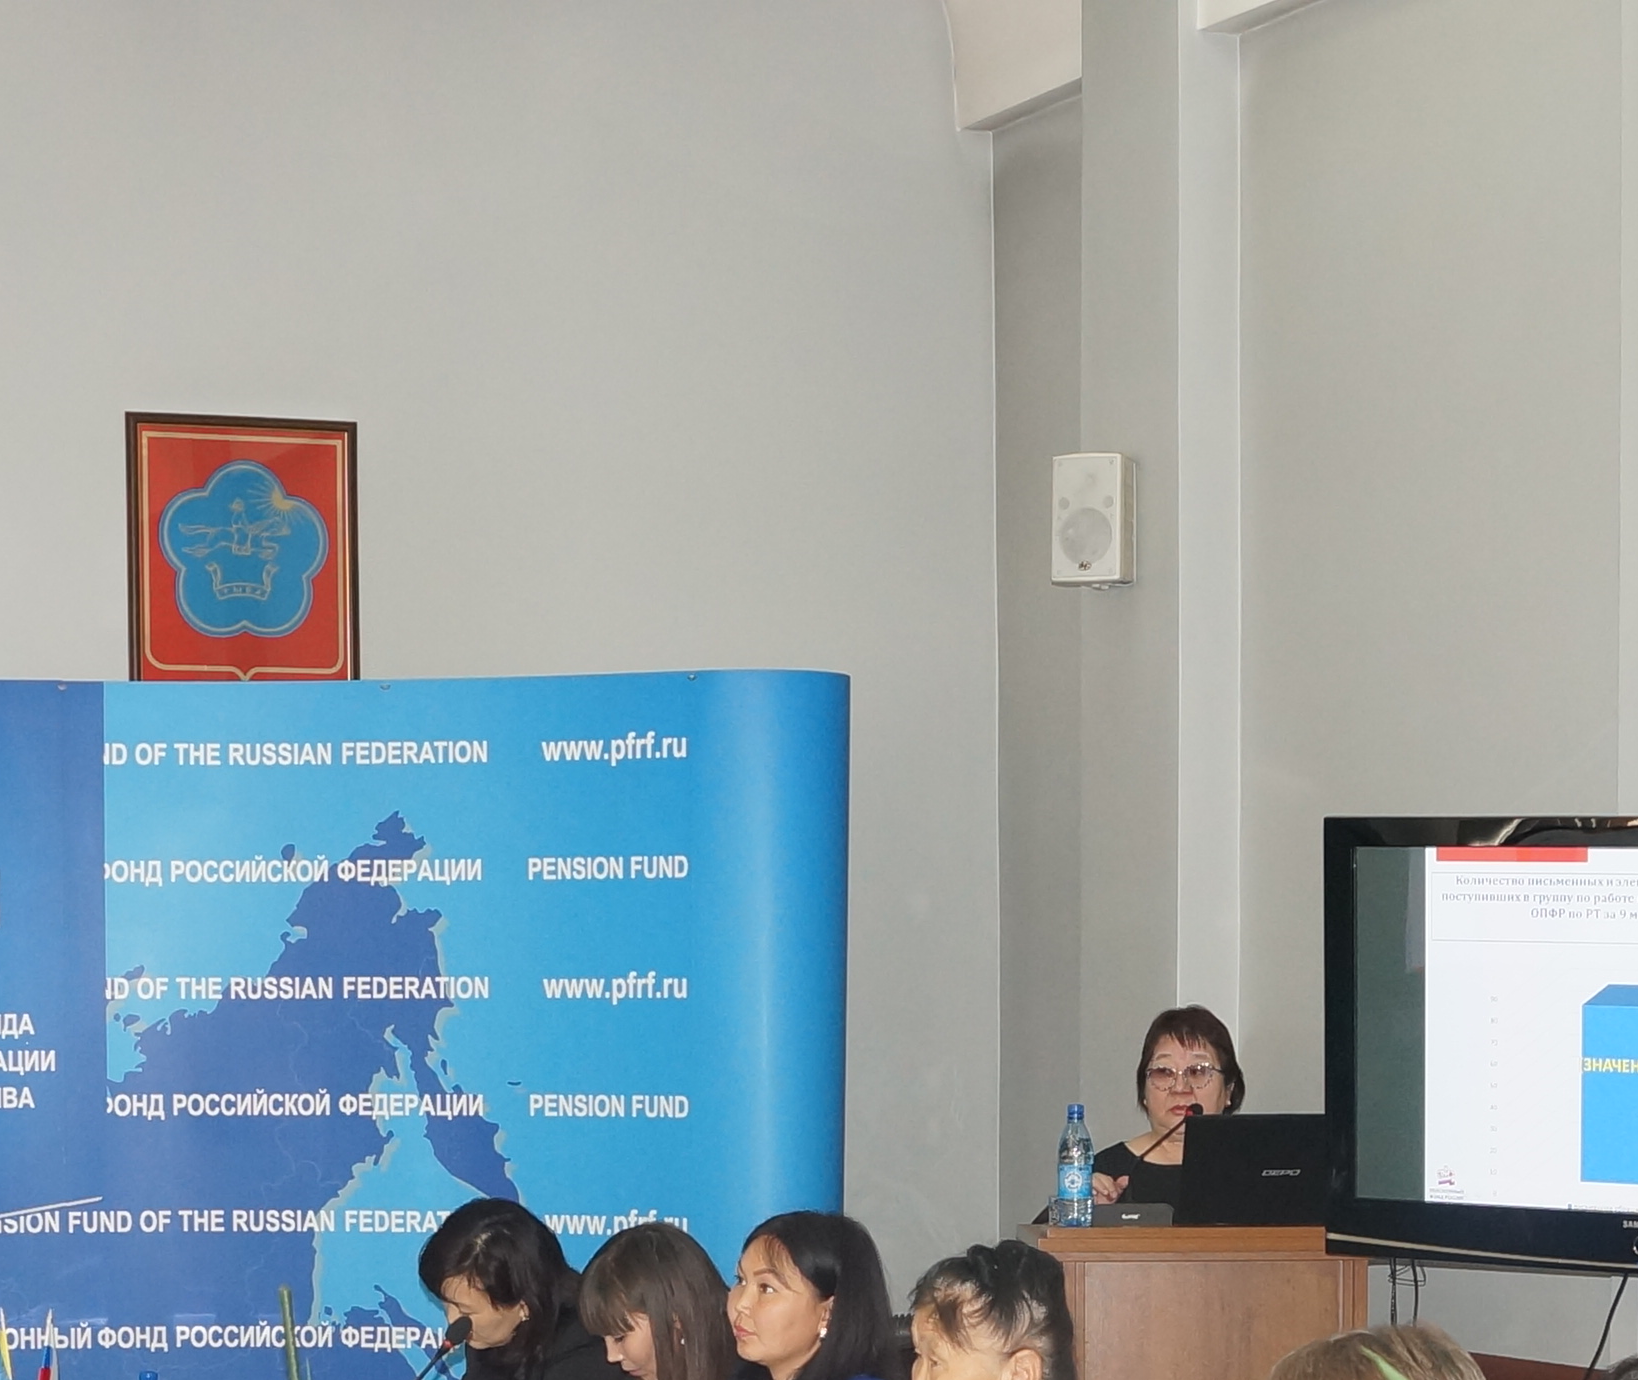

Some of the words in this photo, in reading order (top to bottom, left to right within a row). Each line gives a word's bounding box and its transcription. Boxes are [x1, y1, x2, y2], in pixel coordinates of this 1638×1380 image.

[134, 742, 168, 766] OF
[173, 743, 222, 766] THE
[228, 742, 332, 766] RUSSIAN
[341, 740, 488, 765] FEDERATION
[541, 730, 687, 767] www.pfrf.ru
[170, 854, 329, 883] РОССИЙСКОЙ
[336, 858, 482, 887] ФЕДЕРАЦИИ
[528, 856, 624, 881] PENSION
[630, 855, 689, 879] FUND
[1455, 874, 1523, 887] Количество
[1593, 892, 1635, 906] работе
[1530, 908, 1566, 920] ОПФР
[1585, 909, 1601, 919] РТ
[1619, 909, 1627, 919] 9
[136, 976, 169, 1000] OF
[175, 977, 223, 1000] THE
[229, 976, 333, 1000] RUSSIAN
[343, 975, 489, 1000] FEDERATION
[542, 970, 688, 1006] www.pfrf.ru
[172, 1088, 331, 1116] РОССИЙСКОЙ
[338, 1092, 484, 1121] ФЕДЕРАЦИИ
[529, 1093, 625, 1118] PENSION
[631, 1094, 689, 1119] FUND
[1261, 1169, 1301, 1177] DEPO
[68, 1210, 133, 1234] FUND
[139, 1209, 172, 1233] OF
[177, 1209, 225, 1232] THE
[232, 1209, 335, 1233] RUSSIAN
[97, 1325, 169, 1353] ФОНД
[339, 1325, 446, 1354] ФЕДЕРА
